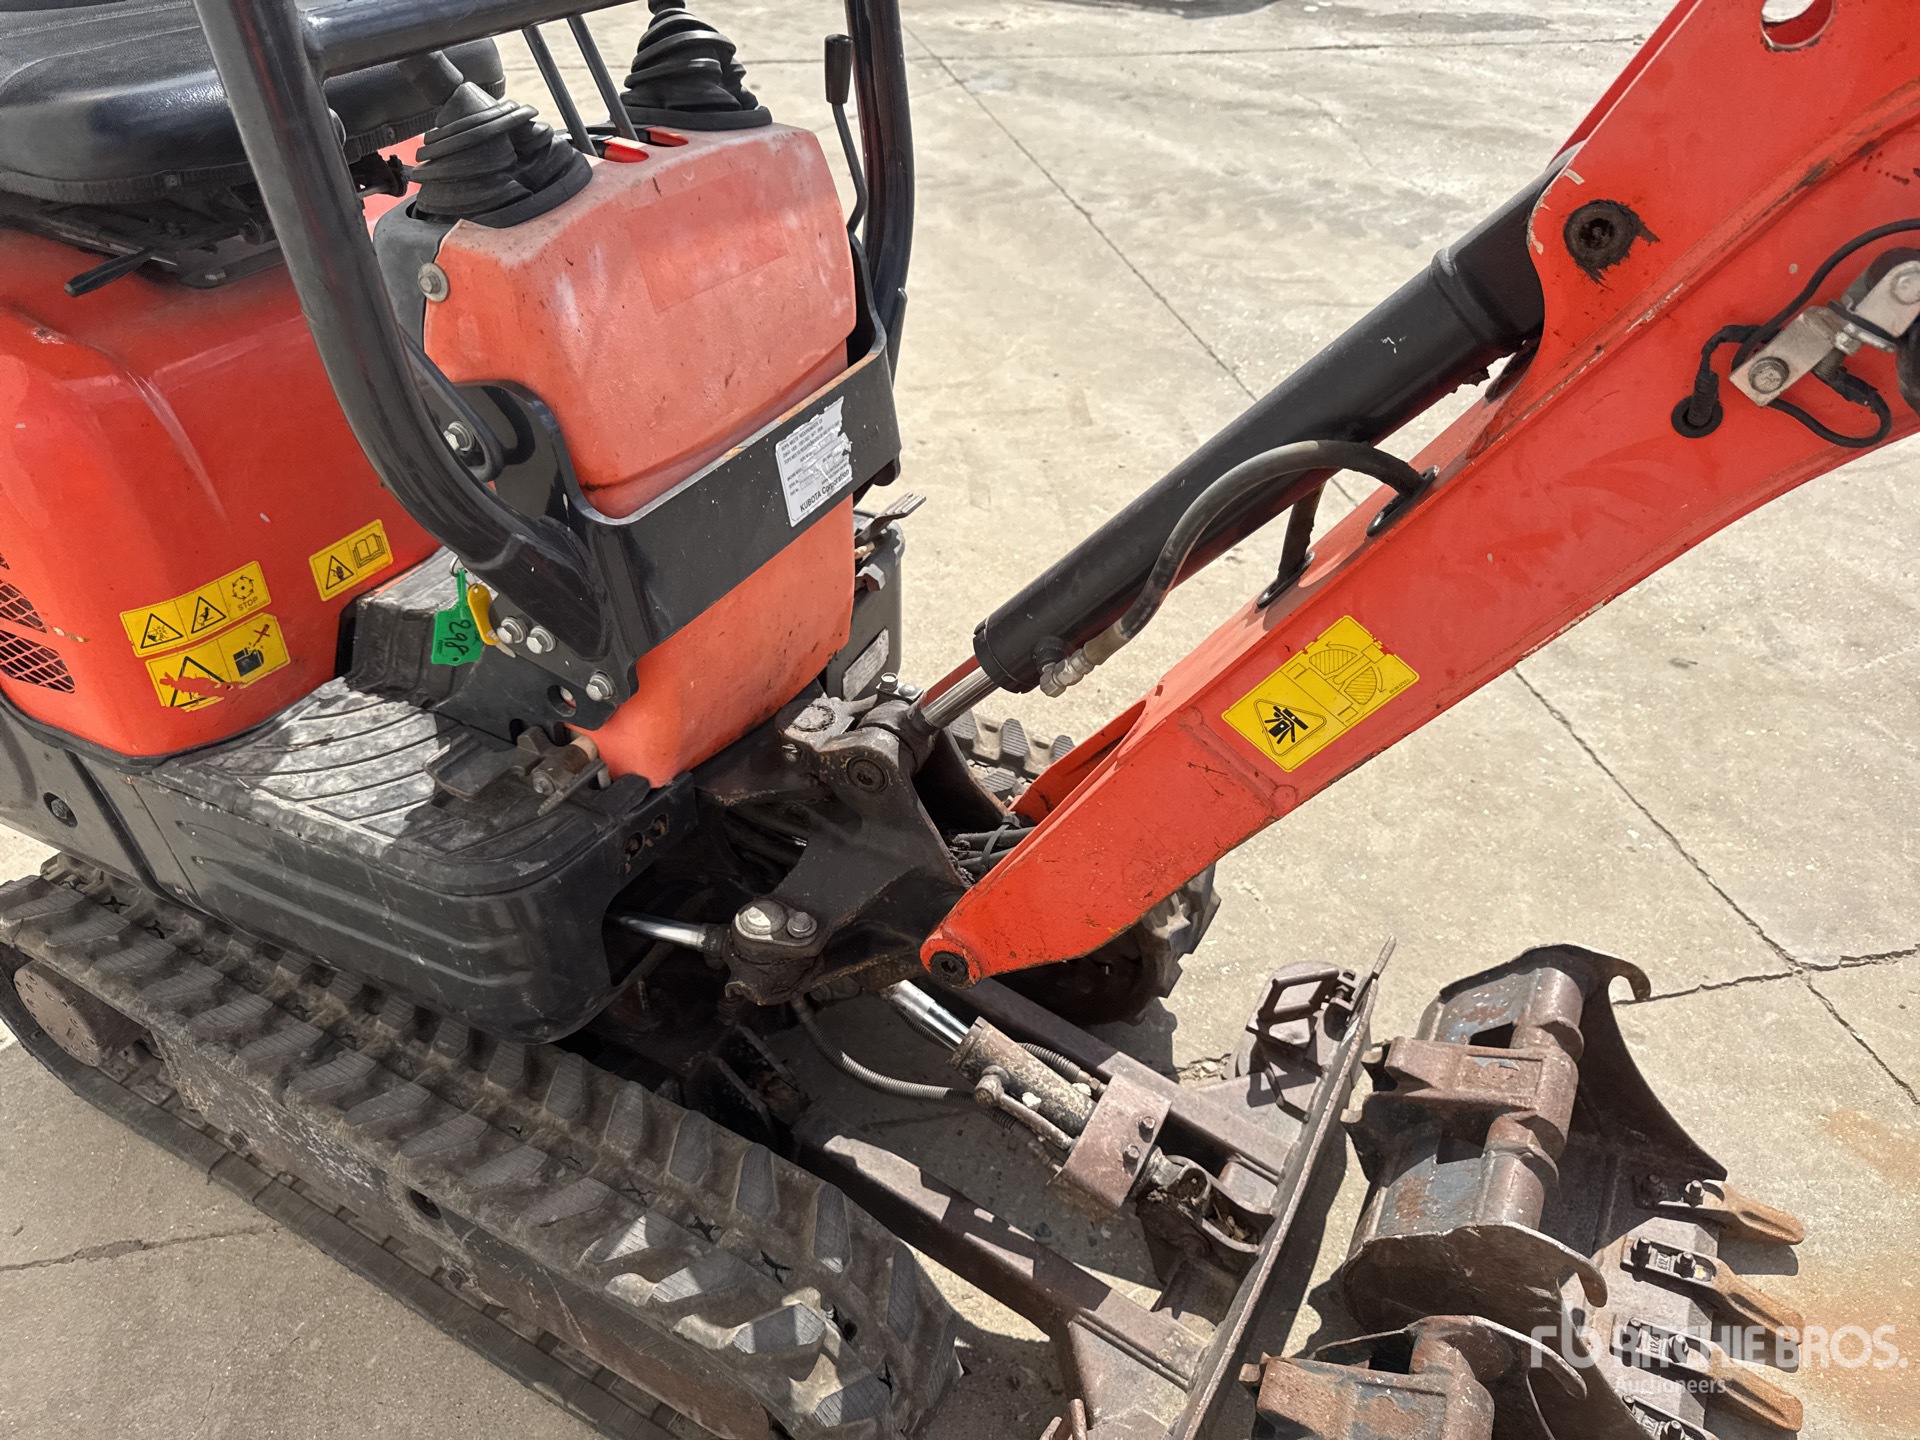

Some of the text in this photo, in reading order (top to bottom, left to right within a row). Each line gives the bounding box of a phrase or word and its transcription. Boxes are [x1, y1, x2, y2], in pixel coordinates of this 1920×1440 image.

[800, 490, 822, 513] KUBOTA
[821, 469, 850, 495] Corporation
[237, 596, 258, 611] STOP
[444, 619, 472, 656] 298
